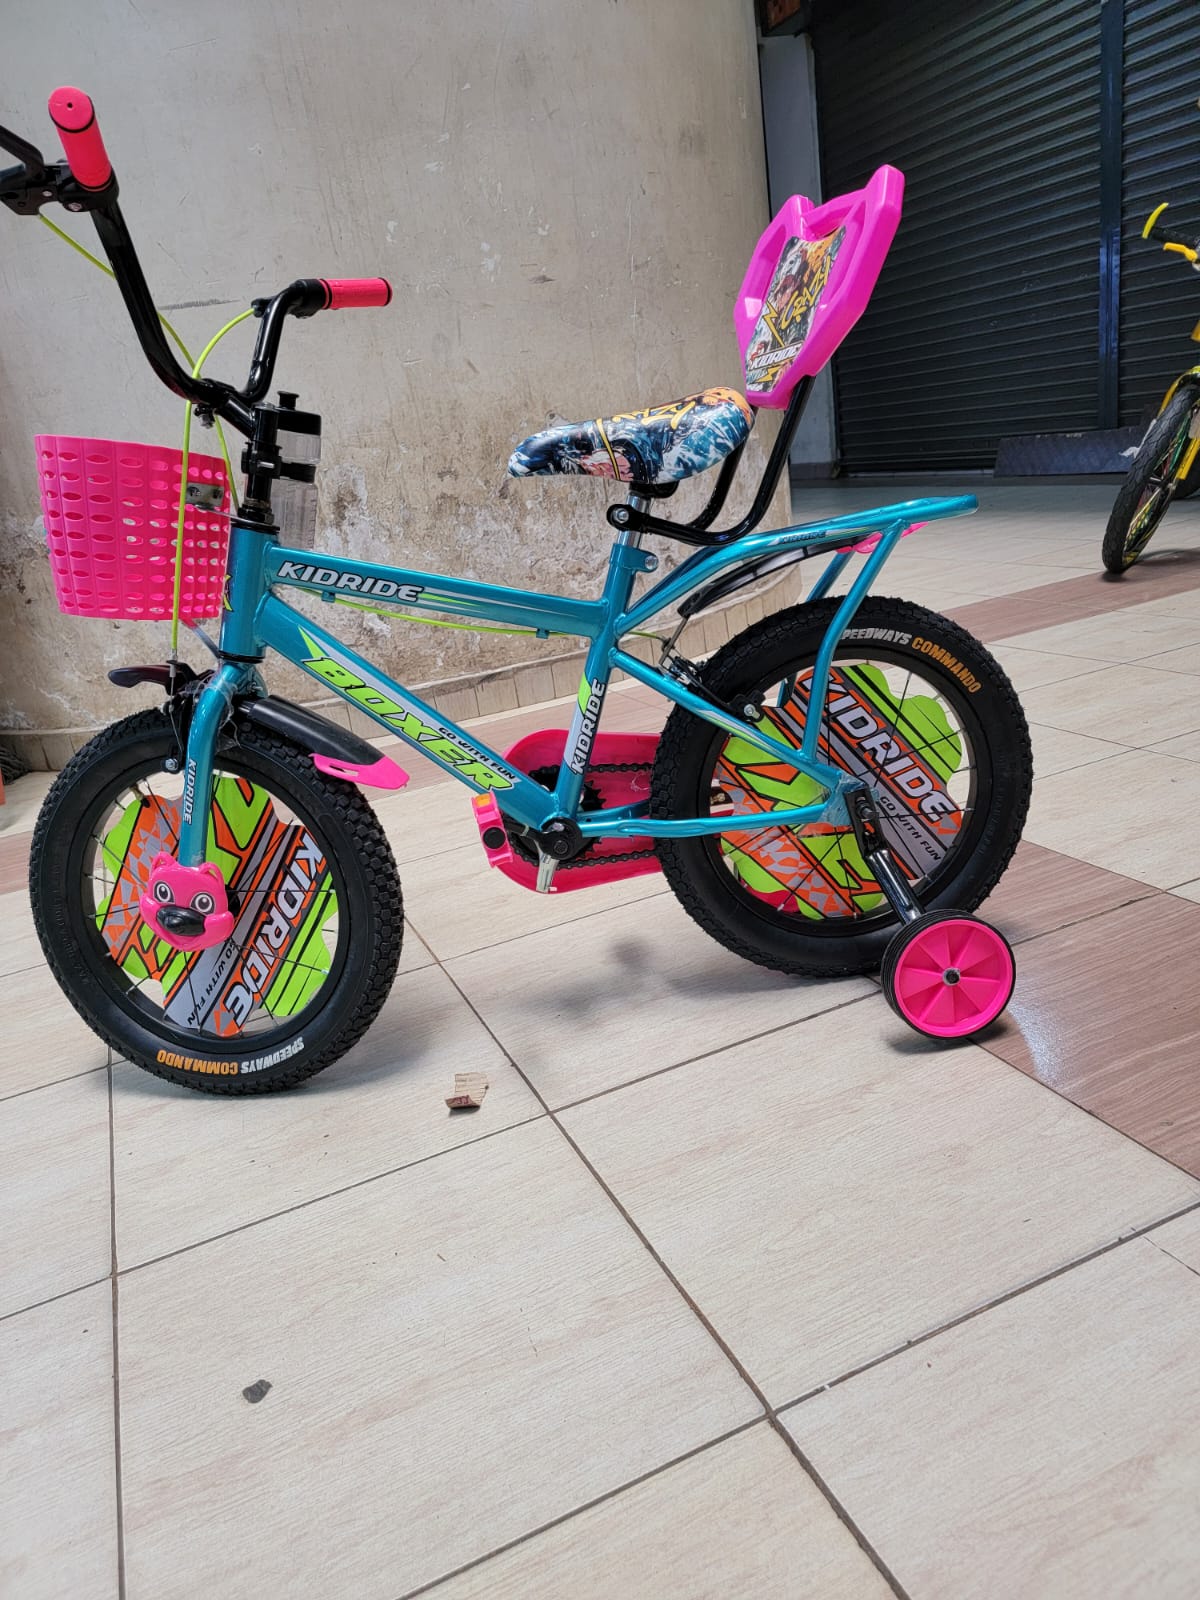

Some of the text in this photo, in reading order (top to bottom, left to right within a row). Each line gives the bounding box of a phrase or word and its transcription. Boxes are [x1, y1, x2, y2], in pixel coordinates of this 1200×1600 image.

[277, 560, 425, 602] KIDRIDE
[841, 627, 982, 694] PEEDWAYS COMMANDO
[302, 657, 514, 790] BOXER
[439, 727, 516, 780] GO WITH FUN
[571, 678, 606, 775] KIDRIDE
[184, 758, 197, 826] KIDRIDE
[880, 796, 896, 811] GO
[920, 840, 941, 861] FUN
[223, 831, 325, 1028] KIDRIDE
[187, 995, 206, 1025] FUN
[205, 960, 226, 996] WITH
[156, 1036, 305, 1076] SPEEDWAYS COMMANDO
